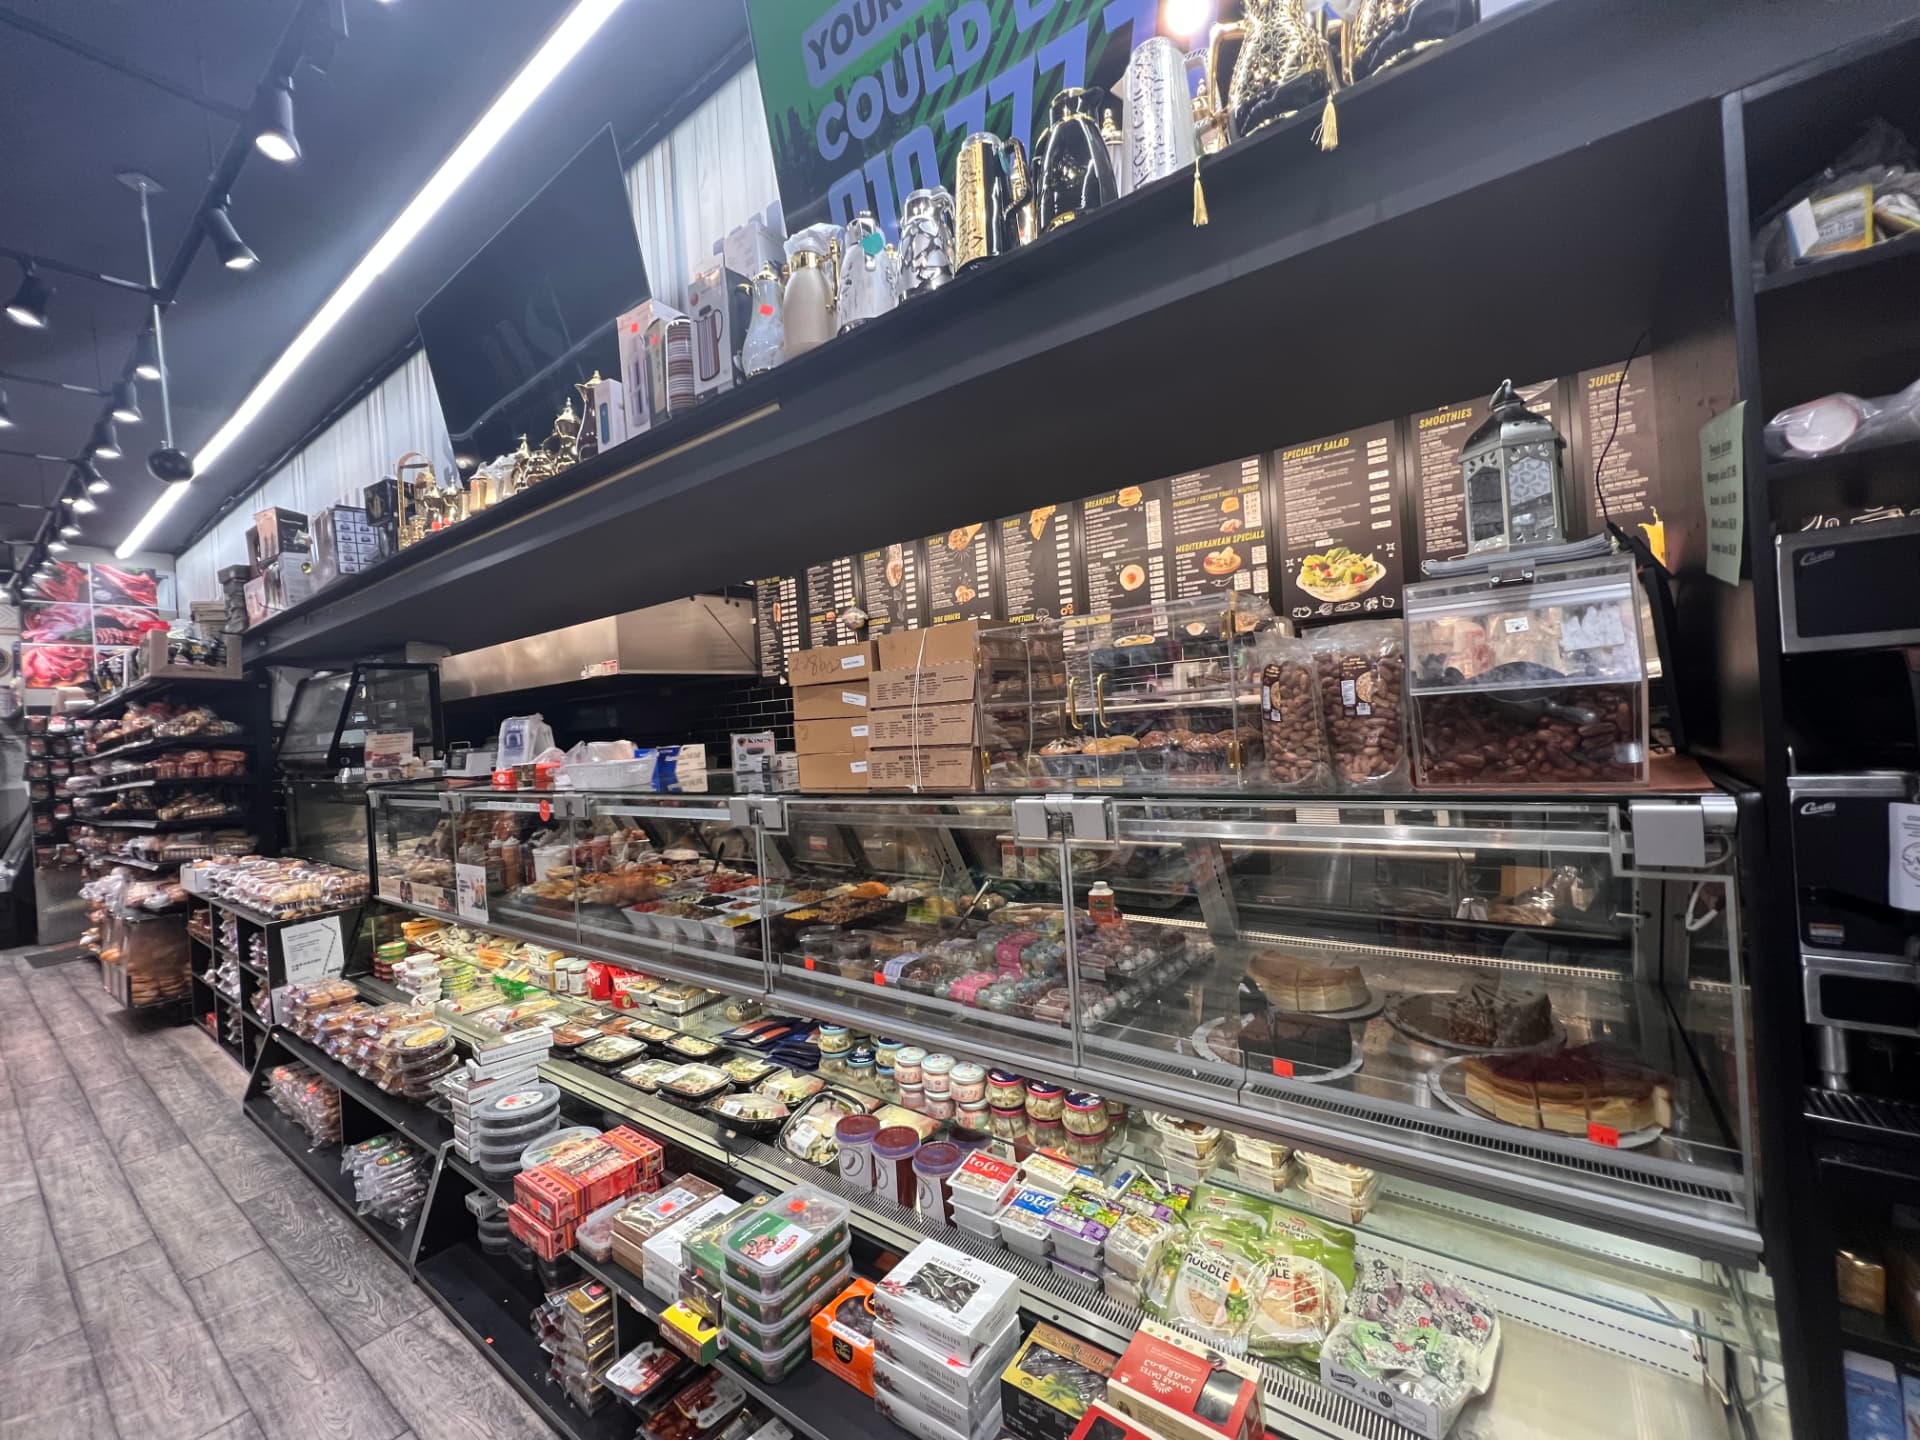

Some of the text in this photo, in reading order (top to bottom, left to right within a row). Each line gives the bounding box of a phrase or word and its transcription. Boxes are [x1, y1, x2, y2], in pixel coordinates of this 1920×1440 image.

[815, 0, 992, 161] COULD
[1418, 407, 1473, 429] SMOOTHIES
[1282, 437, 1350, 461] SPECIALTY SALAD
[1084, 494, 1116, 510] BREAKFAST
[1175, 530, 1265, 553] MEDITERRANEAN SPECIALS
[969, 1156, 1000, 1173] tofu
[1018, 1191, 1057, 1209] tofu
[1139, 1365, 1162, 1381] DATES
